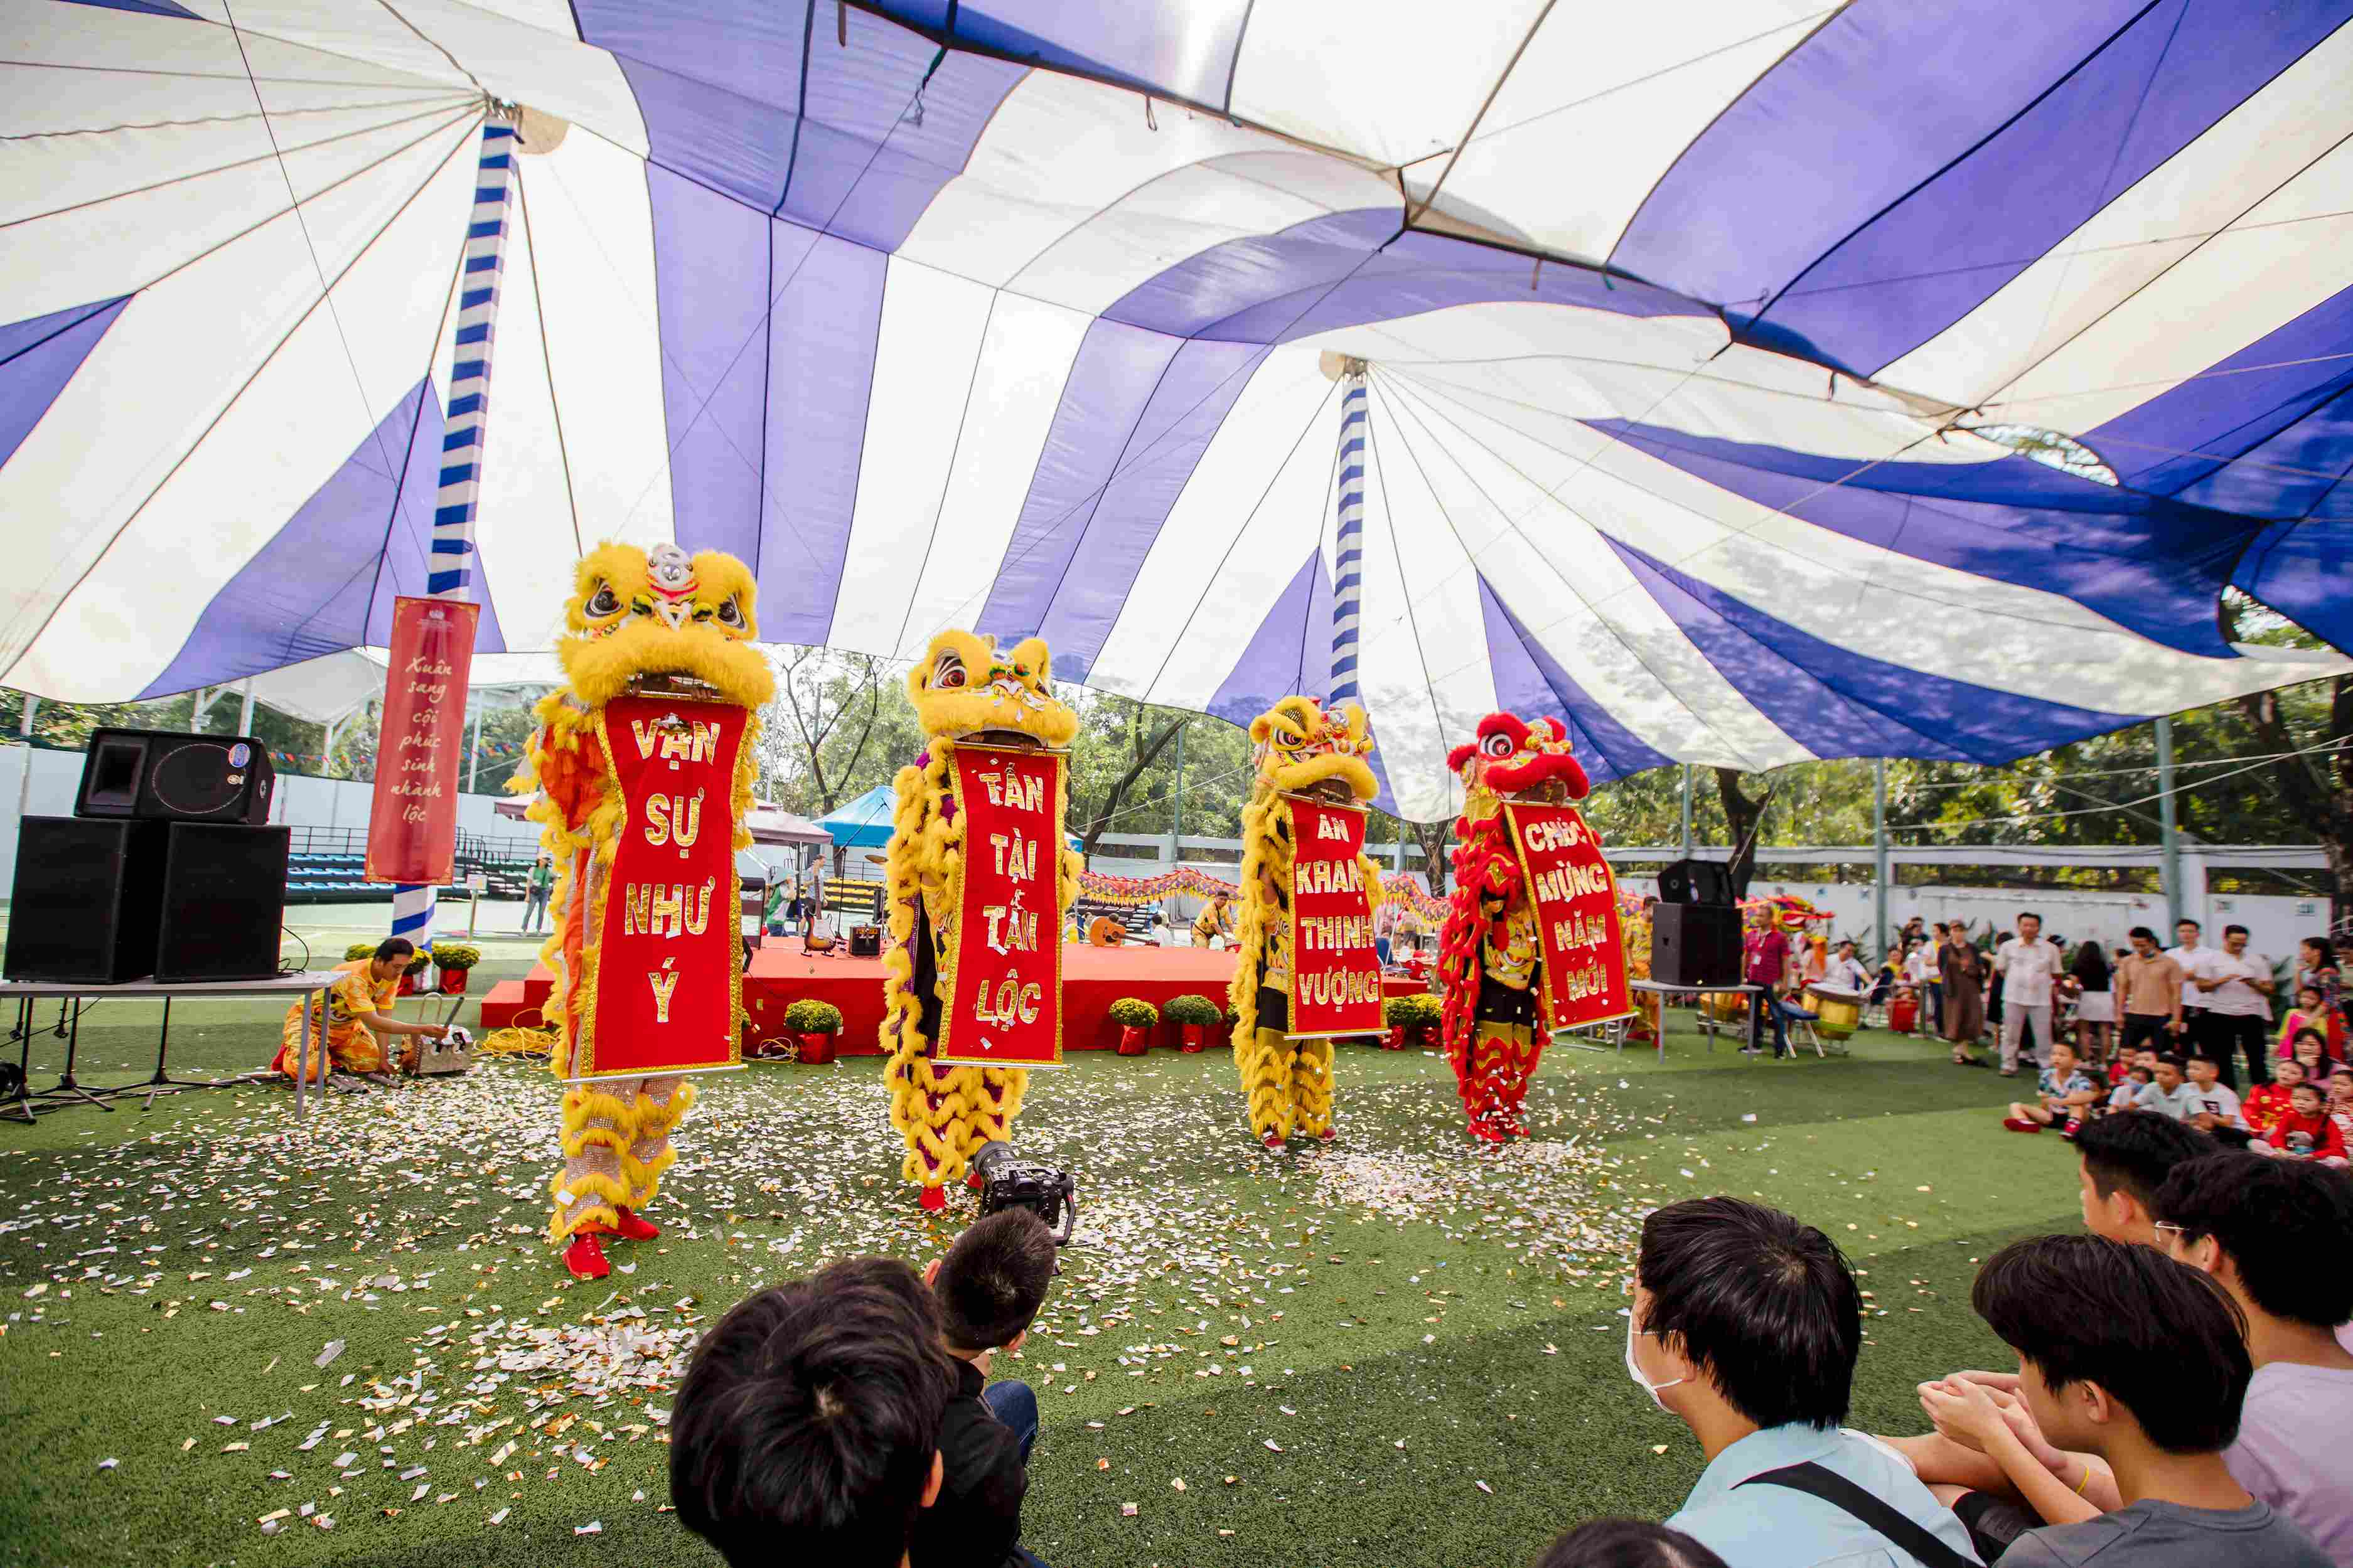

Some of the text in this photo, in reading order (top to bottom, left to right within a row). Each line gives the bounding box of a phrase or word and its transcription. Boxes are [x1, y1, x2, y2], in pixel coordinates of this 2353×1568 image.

[405, 656, 452, 675] Xuân
[408, 681, 448, 703] sang
[412, 708, 439, 727] cội
[399, 731, 442, 751] phúc
[631, 718, 721, 771] VẠN
[402, 755, 436, 773] sinh
[390, 779, 442, 798] nhành
[402, 804, 427, 824] lộc
[645, 787, 705, 859] SỰ
[1318, 814, 1351, 843] AN
[1535, 860, 1609, 903] MỪNG
[624, 876, 716, 937] NHƯ
[1300, 915, 1376, 957] THỊNH
[1554, 909, 1607, 951] NĂM
[648, 956, 680, 1023] Ý
[976, 968, 1042, 1032] LỘC
[1298, 966, 1380, 1013] VƯỢNG
